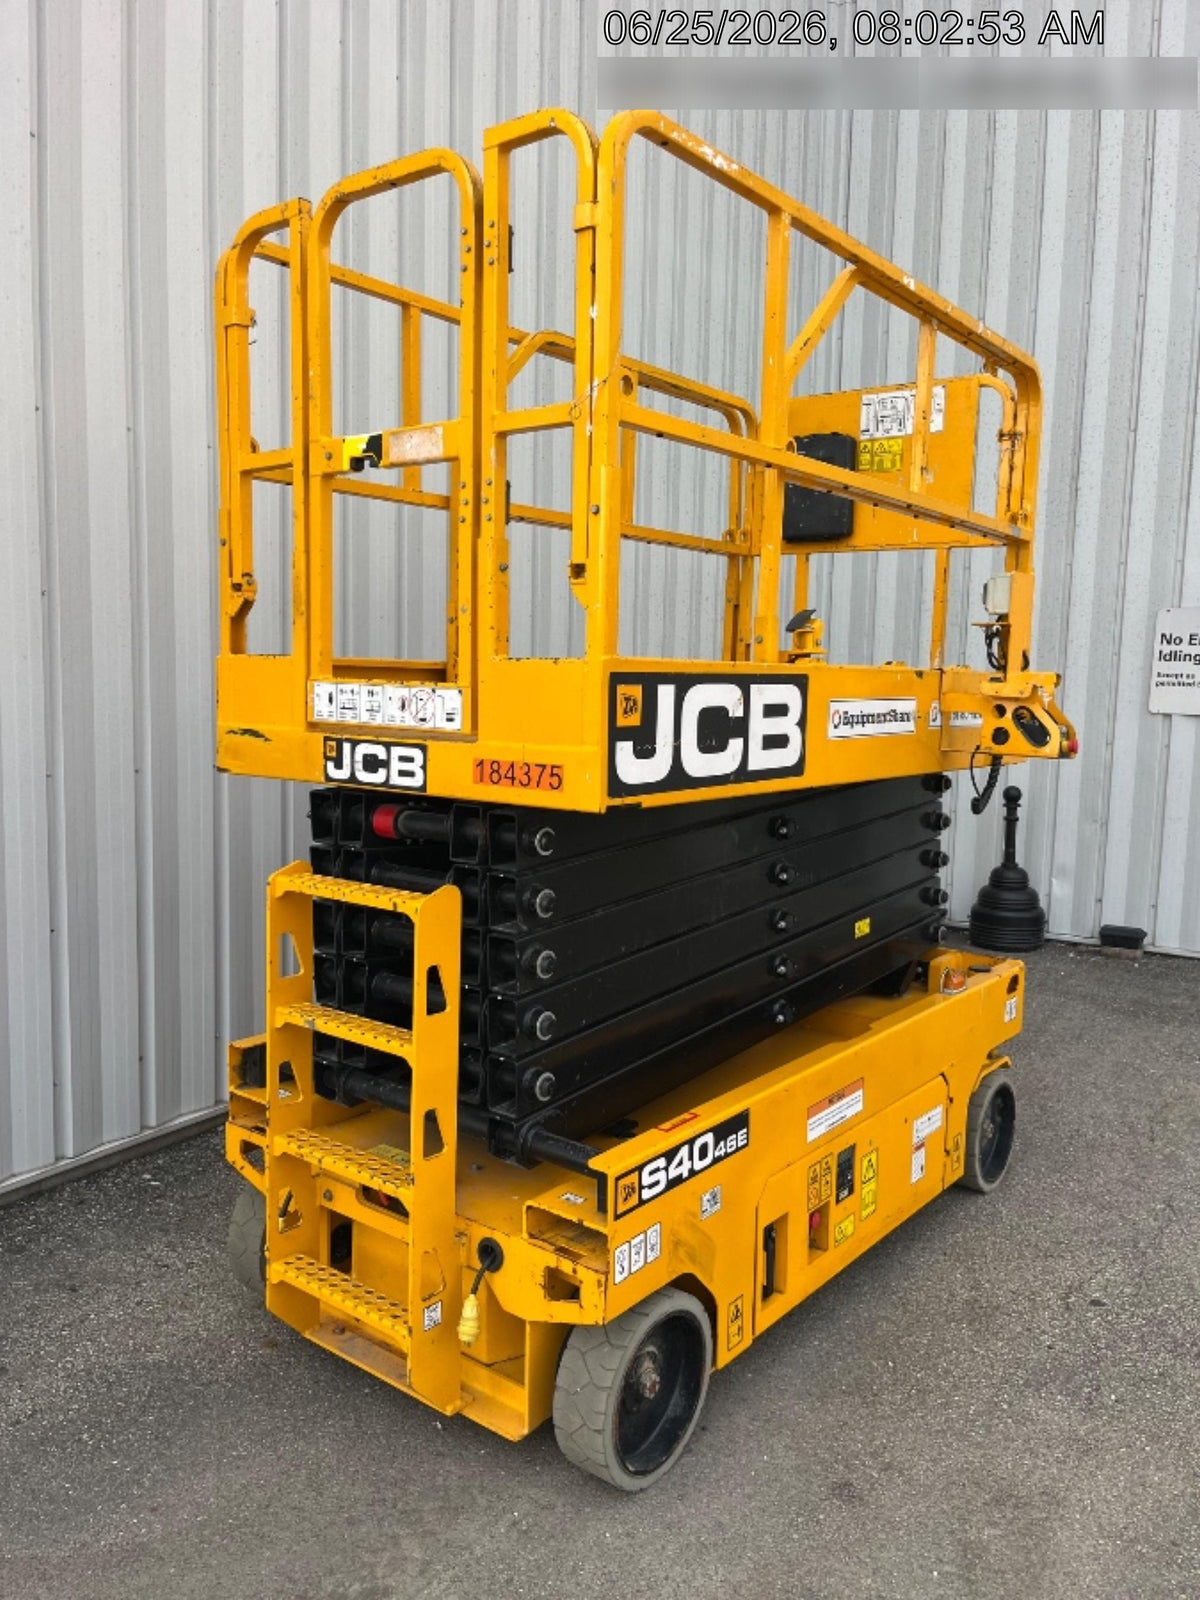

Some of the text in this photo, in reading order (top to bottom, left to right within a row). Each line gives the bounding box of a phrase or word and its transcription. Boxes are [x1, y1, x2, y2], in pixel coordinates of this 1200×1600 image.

[1160, 632, 1200, 646] No E
[1158, 650, 1200, 666] Idling
[615, 683, 803, 785] JCB
[326, 741, 425, 787] JCB
[476, 759, 562, 790] 184375
